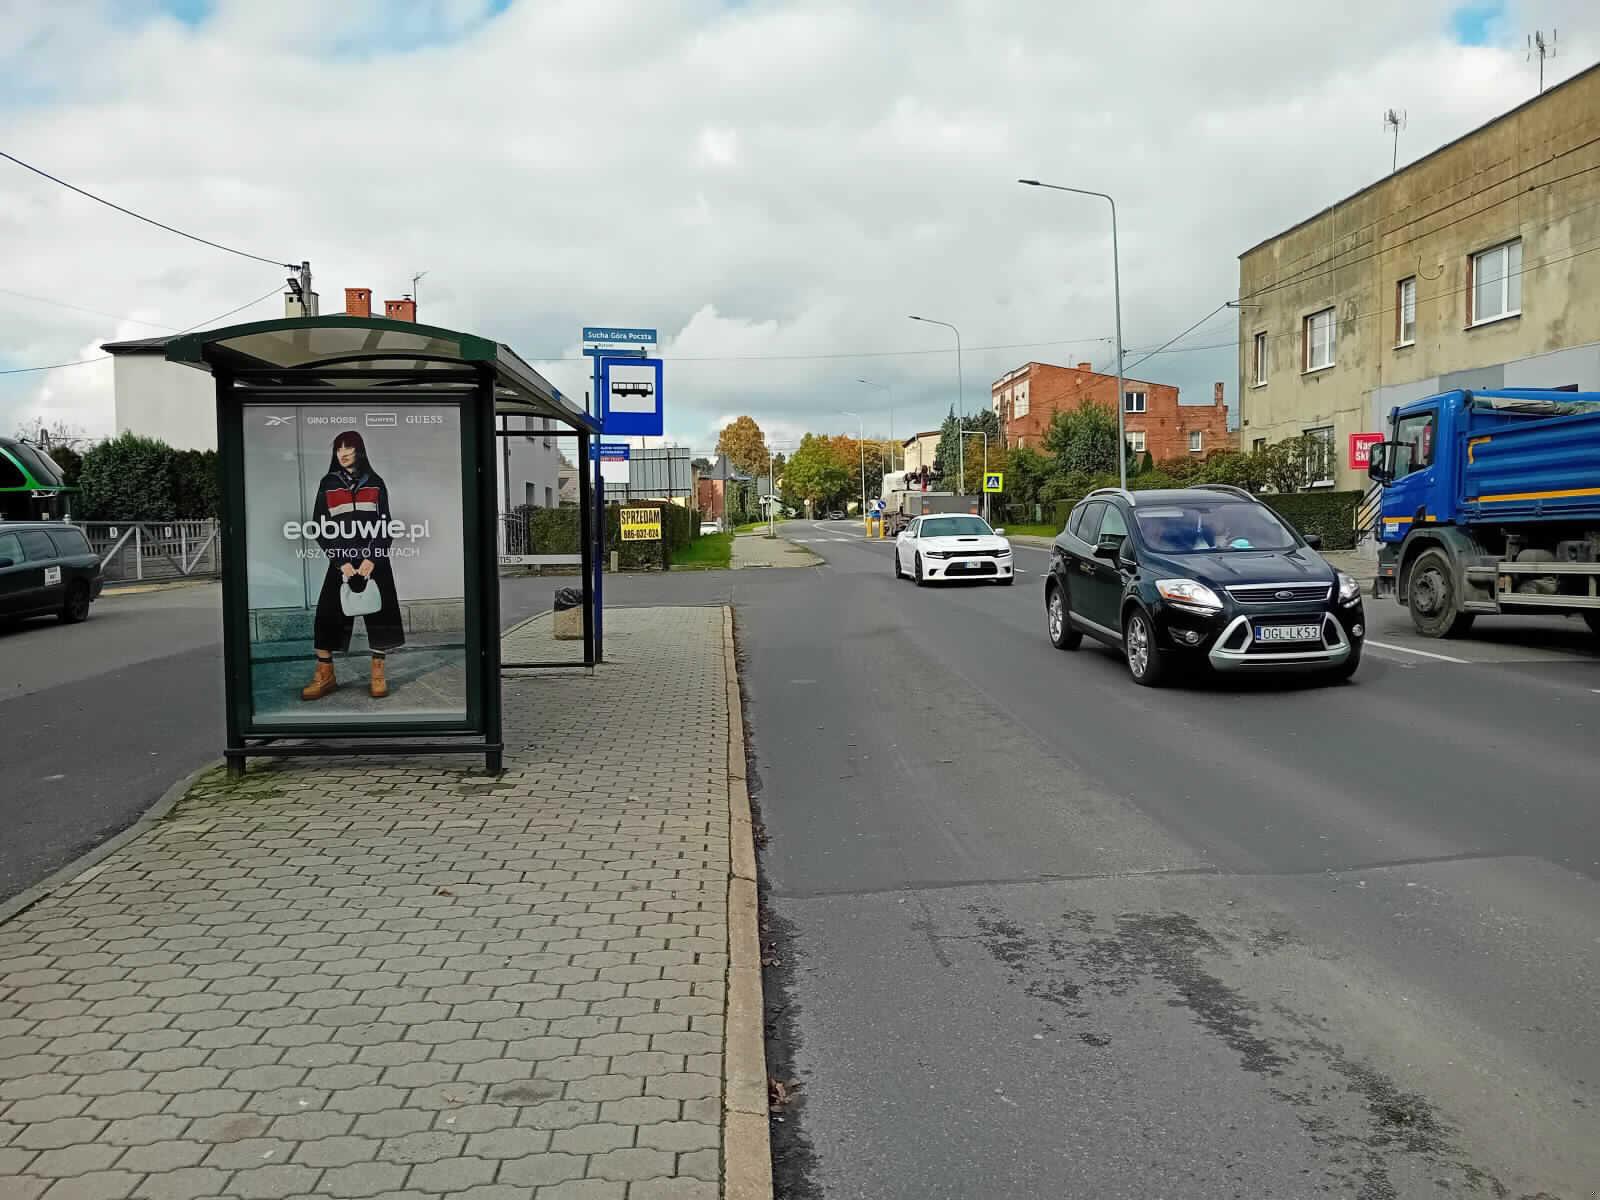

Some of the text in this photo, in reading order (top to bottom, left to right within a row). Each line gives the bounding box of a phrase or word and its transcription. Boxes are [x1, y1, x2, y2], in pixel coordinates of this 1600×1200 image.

[587, 331, 609, 339] Sucha
[628, 332, 652, 340] Poczta
[306, 416, 329, 425] GINO
[330, 416, 357, 424] ROSSI
[405, 415, 443, 424] GUESS
[621, 510, 660, 524] SPRZEDAM
[282, 514, 431, 543] eobuwie.pl
[295, 547, 421, 559] WSZYSTKO O BUTACH
